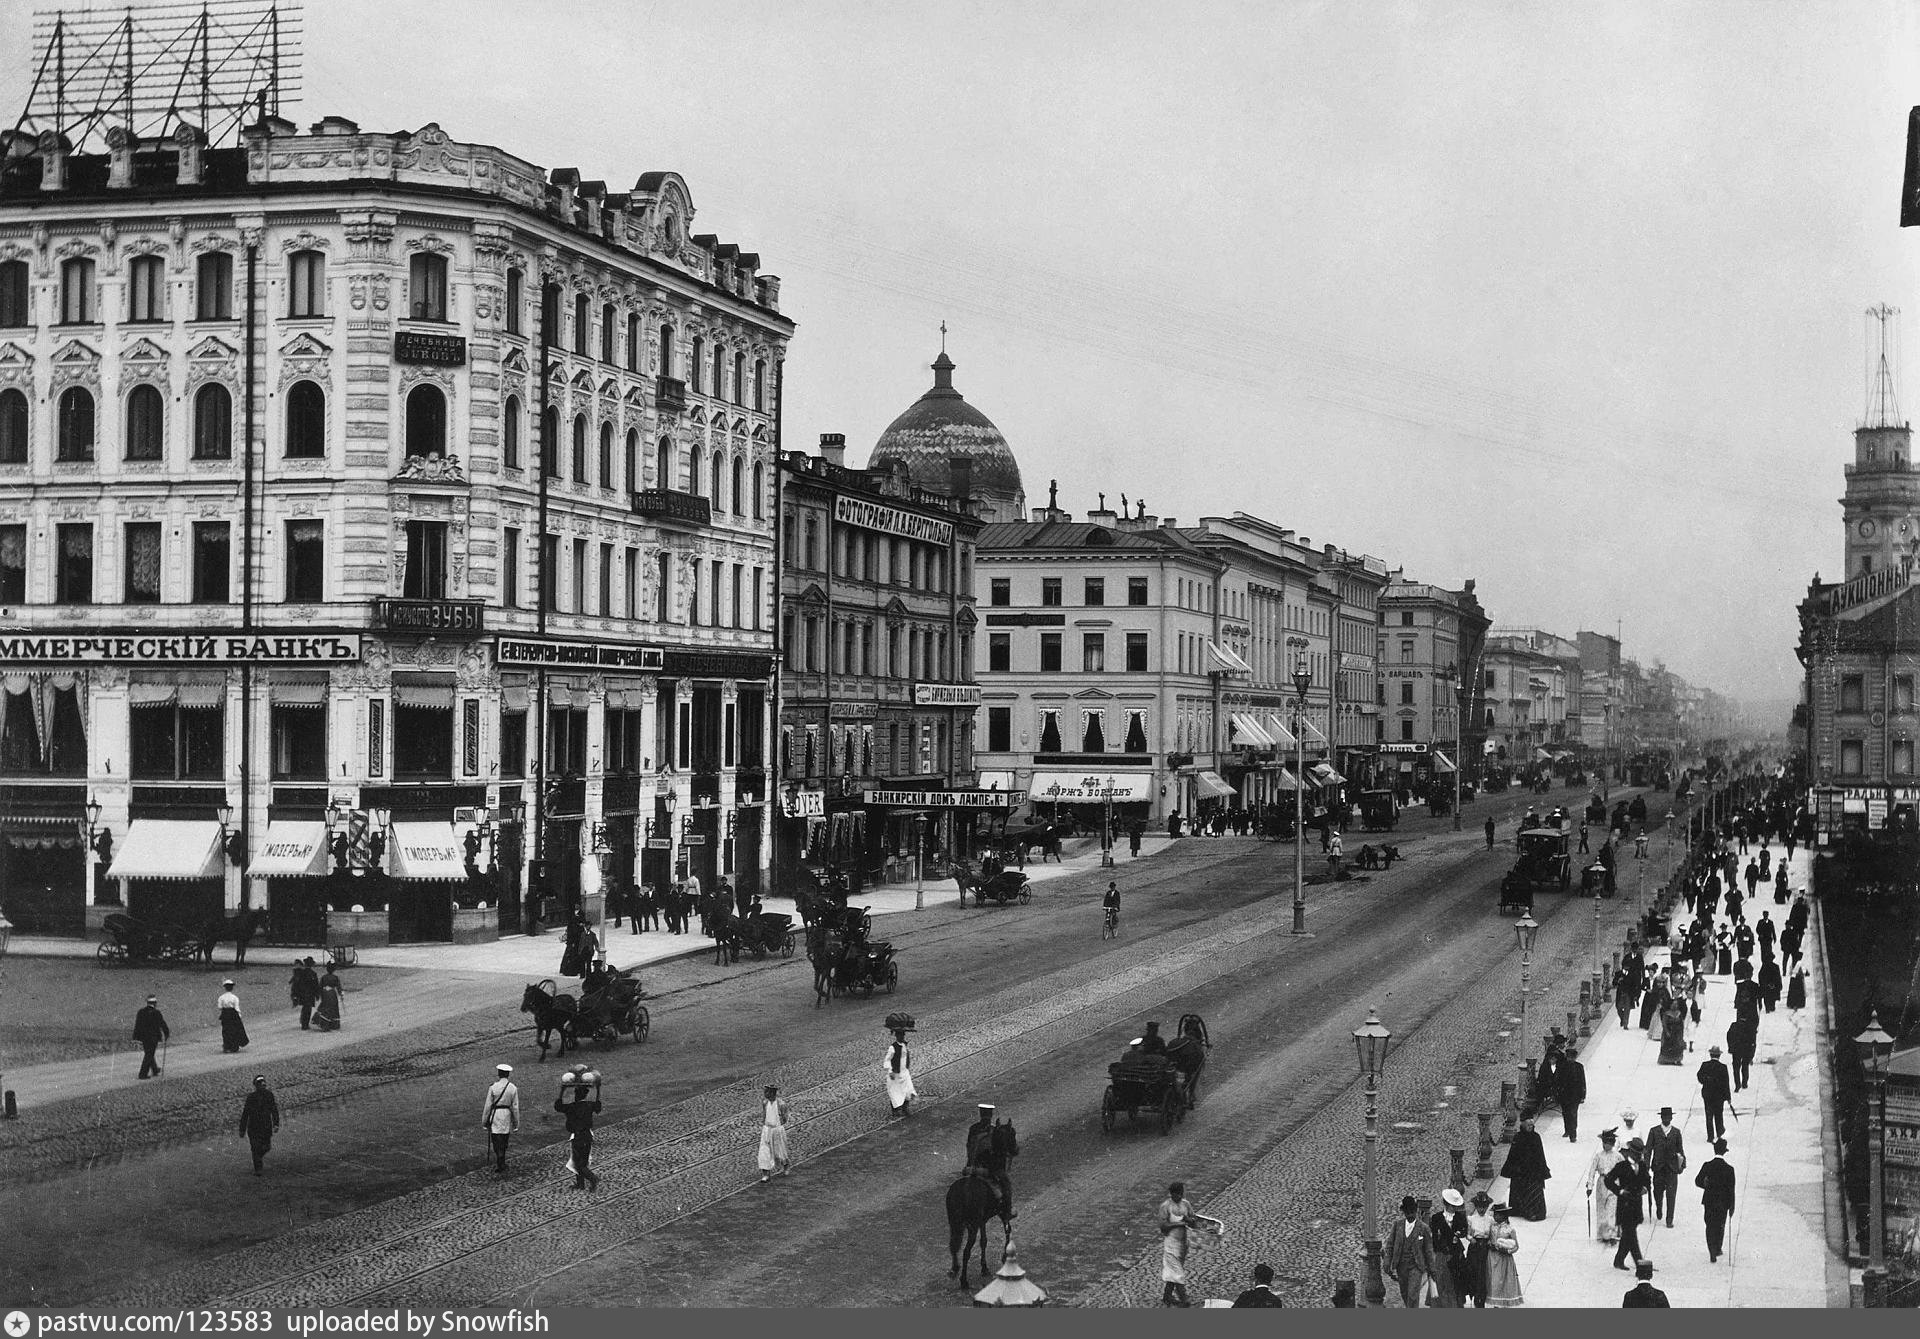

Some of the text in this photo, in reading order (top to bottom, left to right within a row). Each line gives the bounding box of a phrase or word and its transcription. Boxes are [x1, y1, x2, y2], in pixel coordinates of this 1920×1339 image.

[399, 335, 462, 347] ЛЕЧЕБНИЦА
[838, 498, 892, 531] ФОТОГРАФІЯ
[431, 605, 478, 629] ЗУБЫ
[786, 794, 820, 814] OYER
[872, 791, 926, 804] БАНКИРСКІЙ
[930, 793, 955, 805] ДОМЪ
